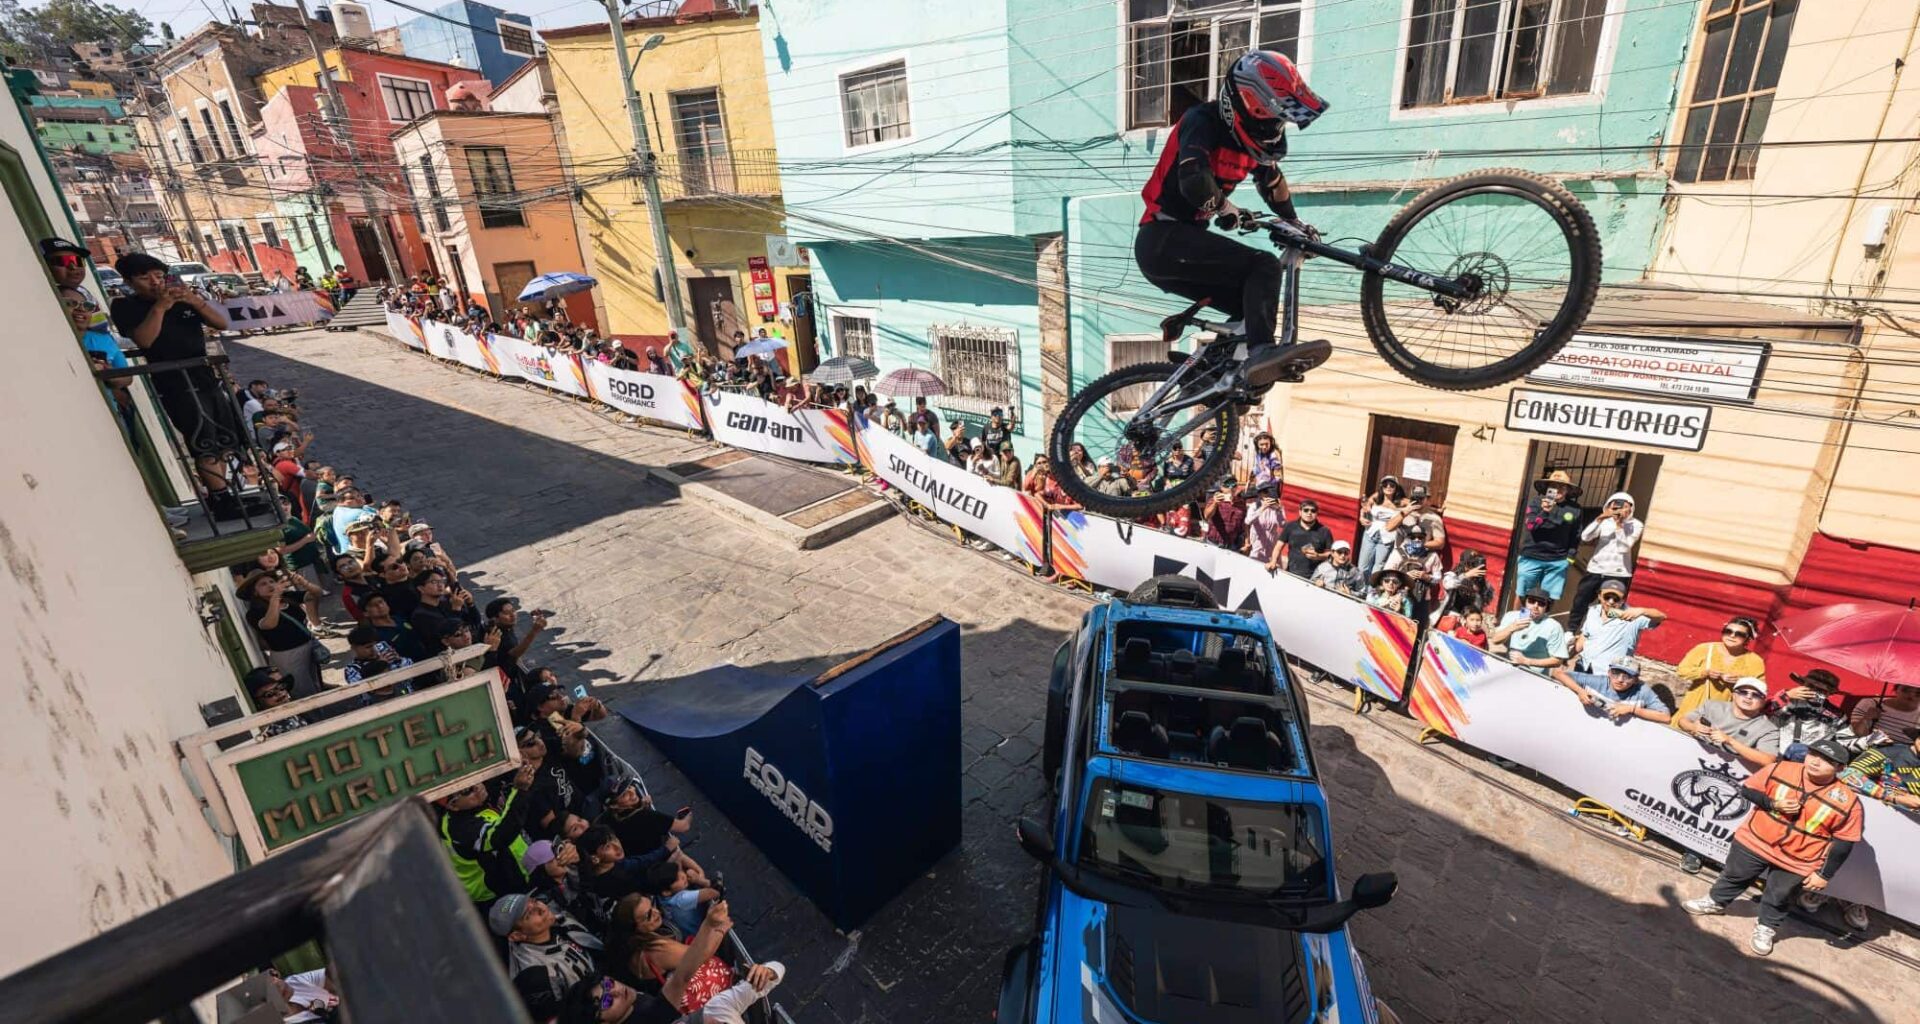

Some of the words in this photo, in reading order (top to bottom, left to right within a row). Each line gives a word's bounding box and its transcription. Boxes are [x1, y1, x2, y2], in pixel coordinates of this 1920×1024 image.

[608, 377, 655, 400] FORD
[1666, 361, 1735, 377] DENTAL
[611, 391, 656, 409] PERFORMANCE
[1514, 399, 1700, 439] CONSULTORIOS
[727, 411, 803, 443] can-am
[1472, 423, 1496, 445] 47
[888, 453, 989, 520] SPECIALIZED
[286, 706, 466, 790] HOTEL
[263, 730, 497, 840] MURILLO
[744, 746, 833, 837] FORD
[743, 767, 832, 853] PERFORMANCE
